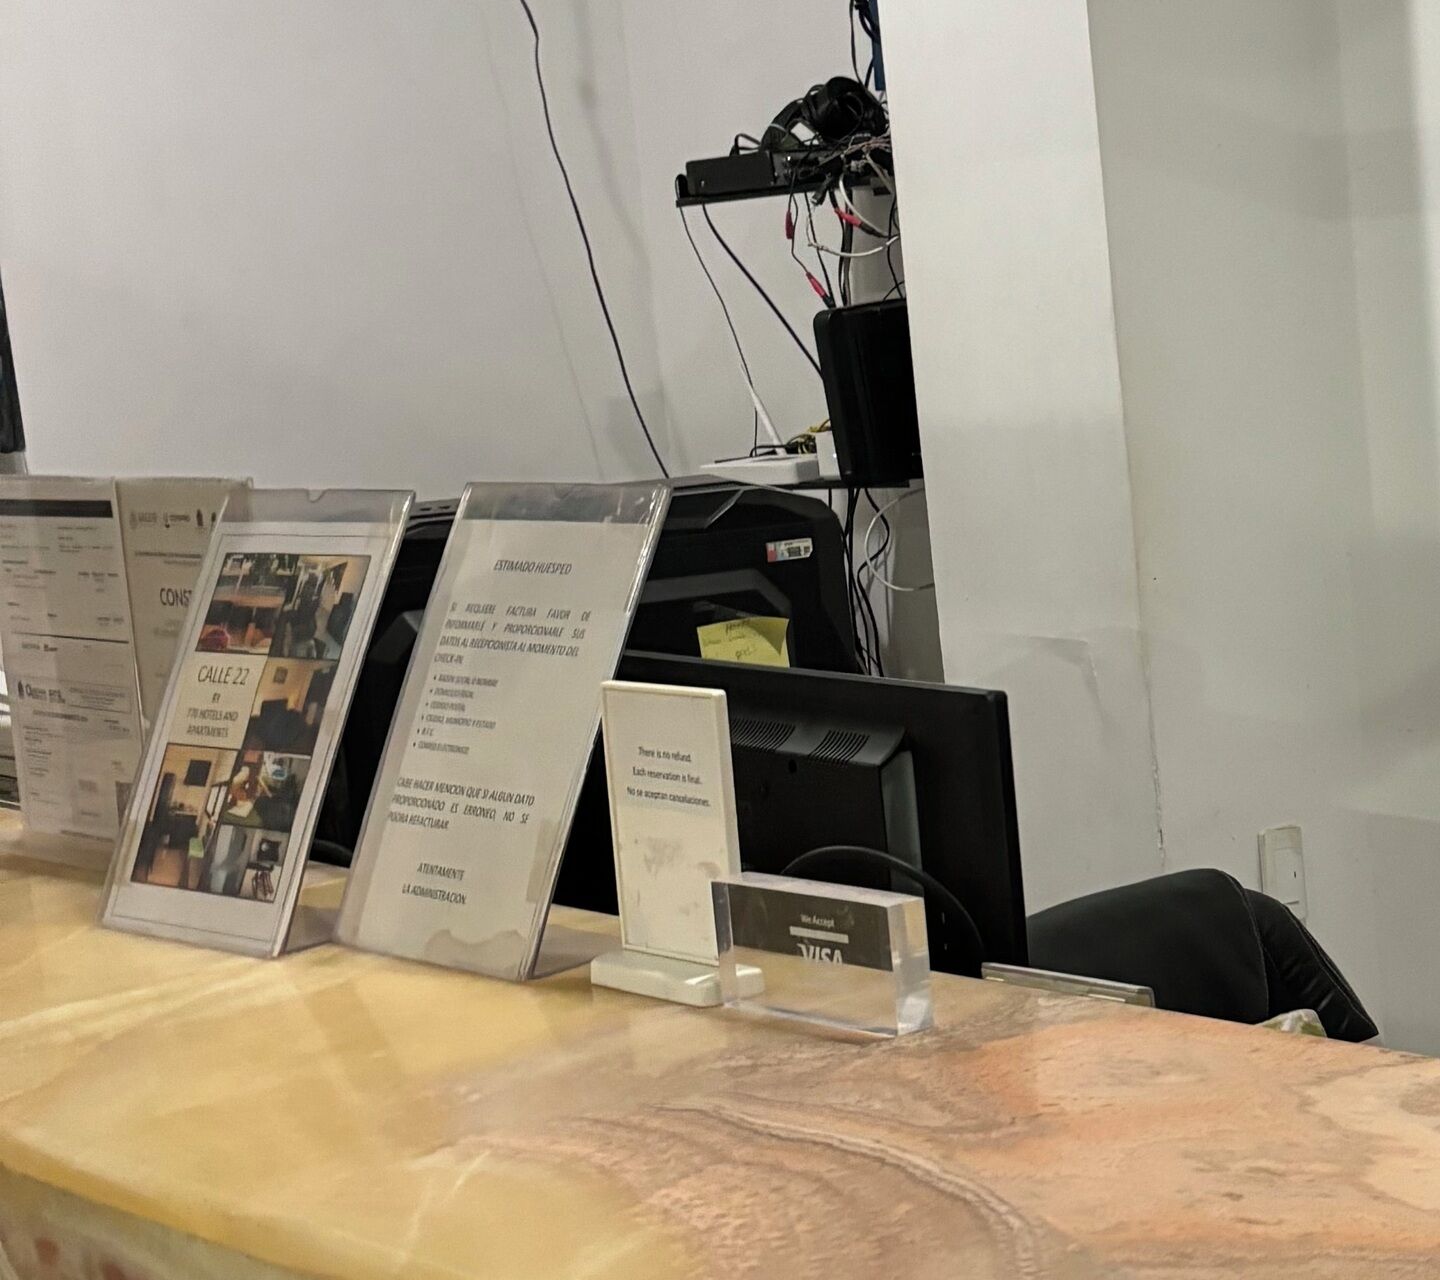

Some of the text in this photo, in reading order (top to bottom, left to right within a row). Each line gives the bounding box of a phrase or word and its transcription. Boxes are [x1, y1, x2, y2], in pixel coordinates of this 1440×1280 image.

[493, 559, 573, 576] ESTIMADO HUESPED
[505, 605, 537, 617] FACTURA
[546, 607, 571, 620] FAVOR
[581, 610, 592, 622] DE
[571, 627, 586, 640] SUS
[440, 635, 461, 647] DATOS
[526, 642, 566, 656] MOMENTO
[565, 645, 580, 657] DEL
[197, 665, 250, 686] CALLE 22
[222, 711, 240, 722] AND
[638, 746, 655, 758] There
[662, 751, 670, 760] no
[632, 766, 646, 776] Each
[647, 770, 681, 781] reservation
[413, 779, 435, 791] HACER
[434, 782, 465, 796] MENCION
[465, 786, 482, 799] QUE
[513, 793, 536, 807] DATO
[626, 786, 636, 796] No
[636, 788, 643, 797] se
[644, 790, 668, 800] aceptan
[450, 802, 459, 814] ES
[502, 810, 515, 823] NO
[520, 812, 530, 824] SE
[416, 862, 466, 881] ATENTAMENTE
[800, 913, 835, 929] We Accept
[796, 943, 843, 965] VISA
